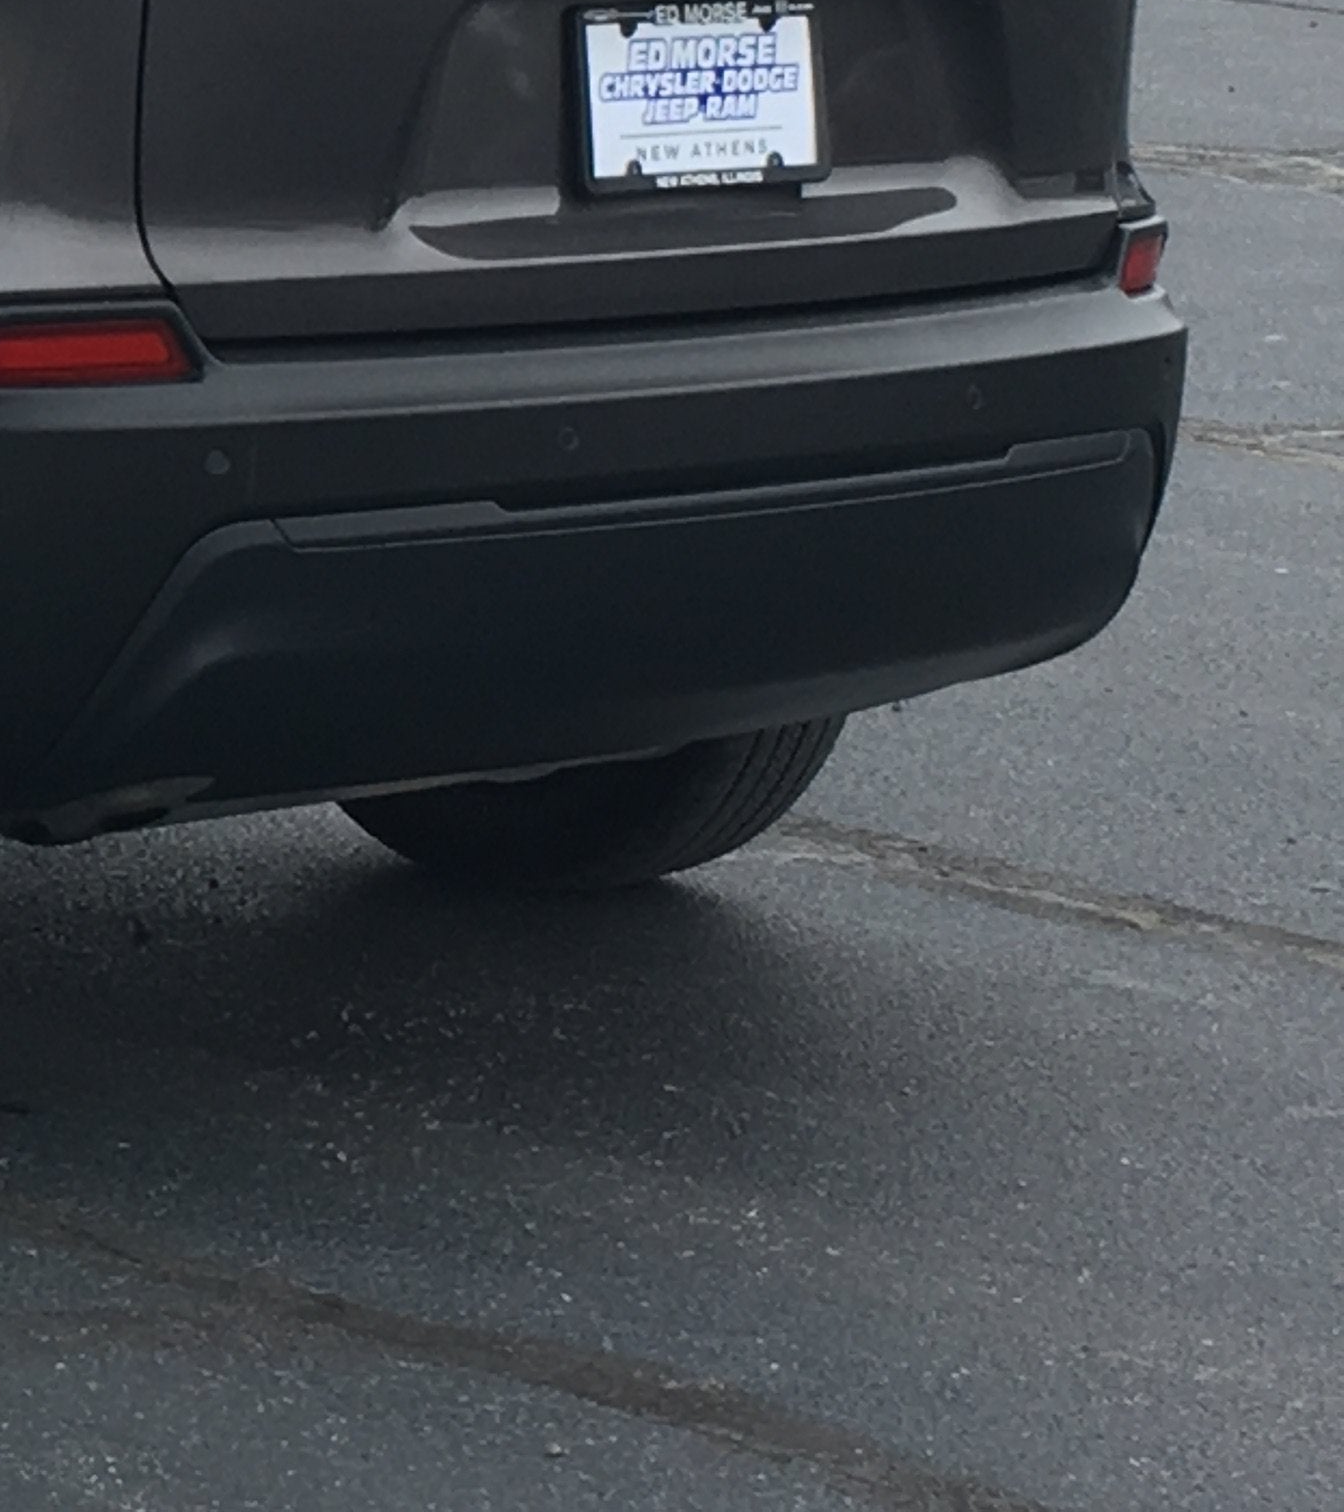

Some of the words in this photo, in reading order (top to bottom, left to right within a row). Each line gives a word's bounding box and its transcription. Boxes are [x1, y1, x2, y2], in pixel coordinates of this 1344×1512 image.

[654, 4, 679, 25] ED
[684, 1, 747, 24] MORSE
[628, 38, 667, 70] ED
[671, 33, 776, 69] MORSE
[599, 70, 716, 100] CHRYSLER
[721, 65, 799, 94] DODGE
[636, 144, 680, 163] NEW
[690, 138, 768, 157] ATHENS
